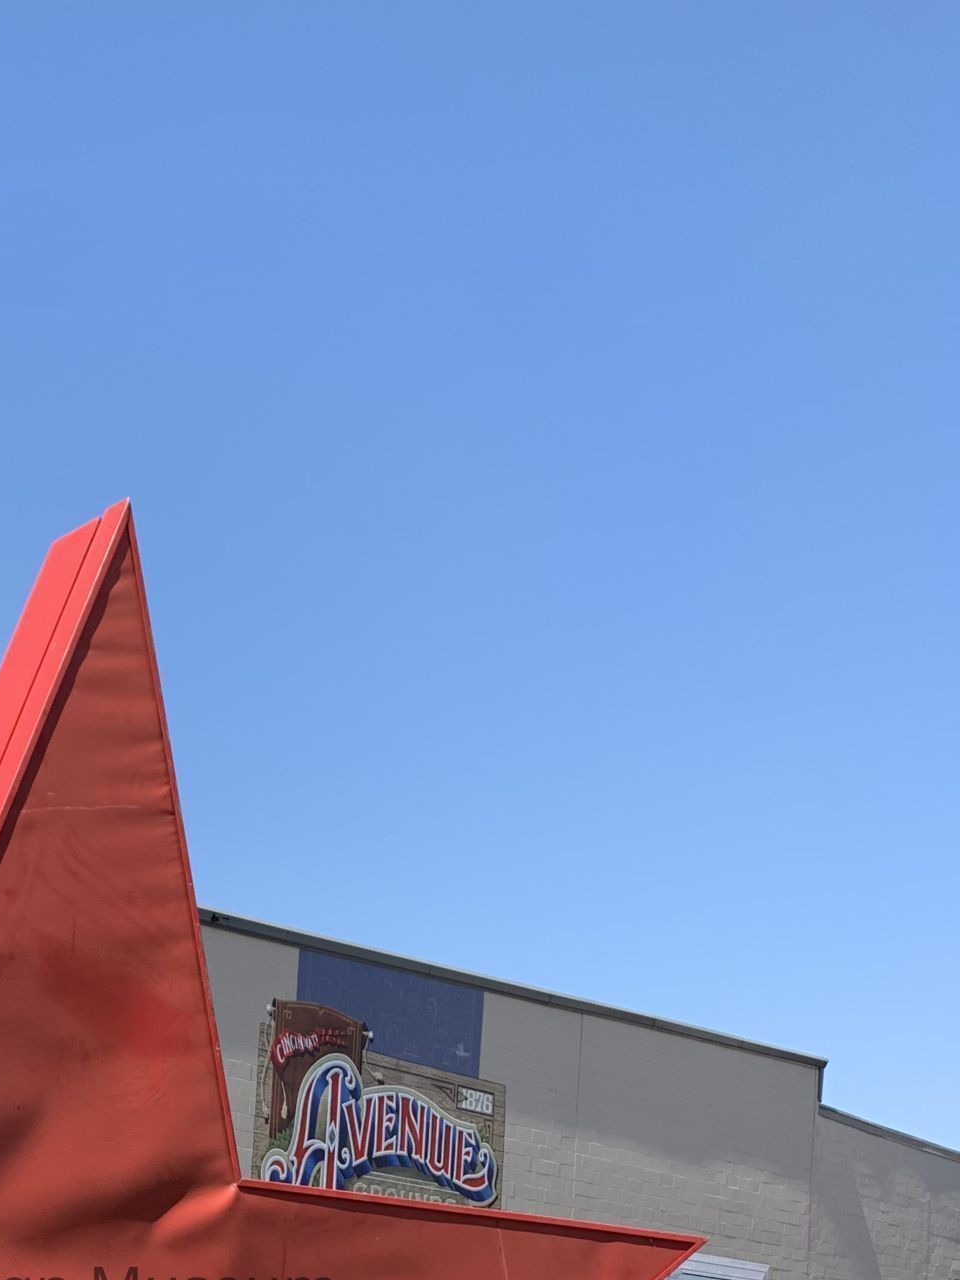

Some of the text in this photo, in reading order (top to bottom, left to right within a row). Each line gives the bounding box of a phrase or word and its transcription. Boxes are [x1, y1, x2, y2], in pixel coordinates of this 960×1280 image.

[276, 1032, 318, 1063] CINCINNATI
[461, 1088, 492, 1114] 1876
[265, 1061, 493, 1196] AVENUE
